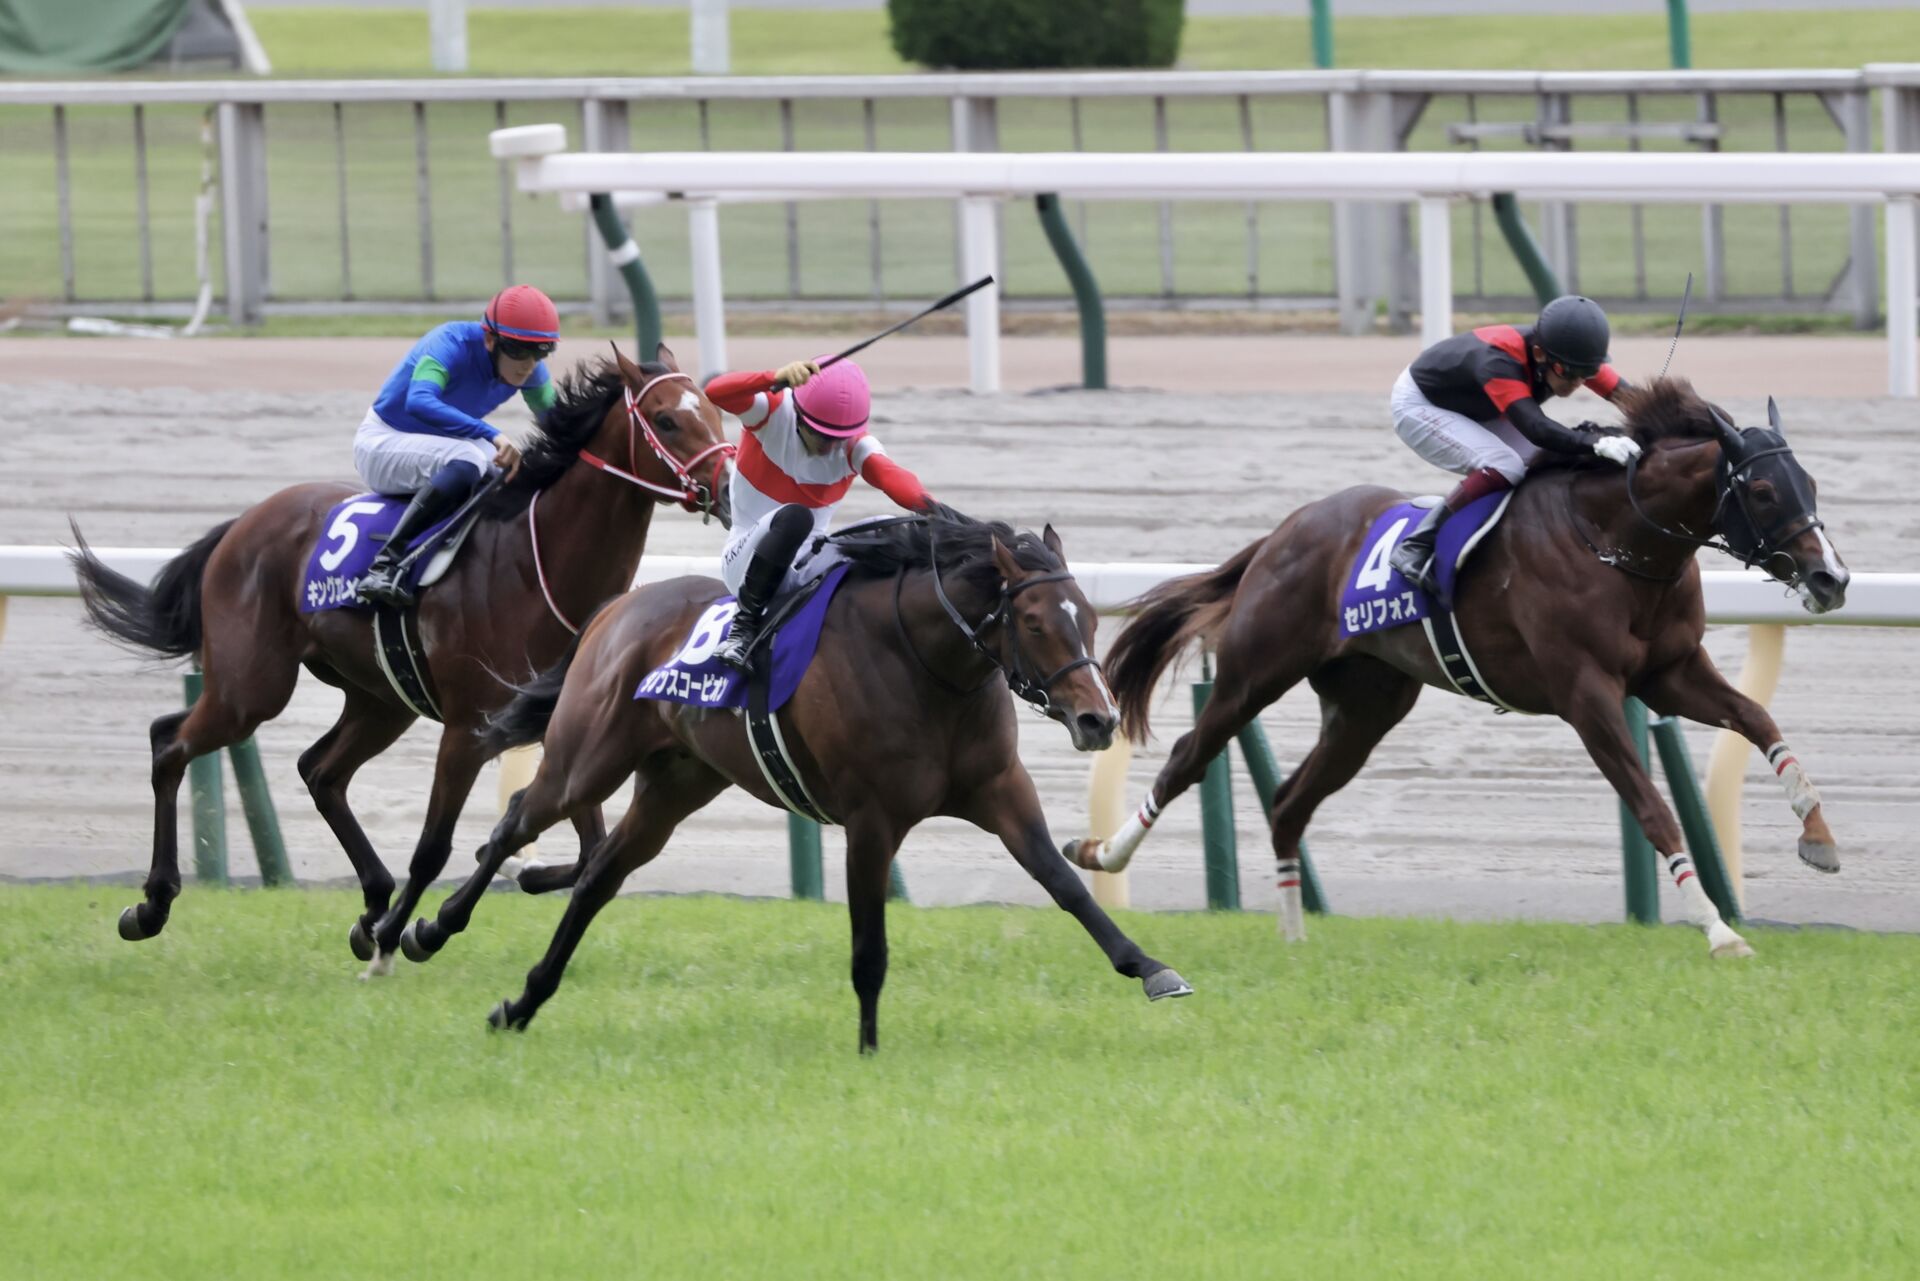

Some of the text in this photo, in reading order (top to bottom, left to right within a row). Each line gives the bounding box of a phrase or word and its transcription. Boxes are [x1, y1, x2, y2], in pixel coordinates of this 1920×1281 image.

[320, 502, 385, 571] 5
[1355, 518, 1409, 591] 4
[1344, 591, 1417, 633] セリフォス
